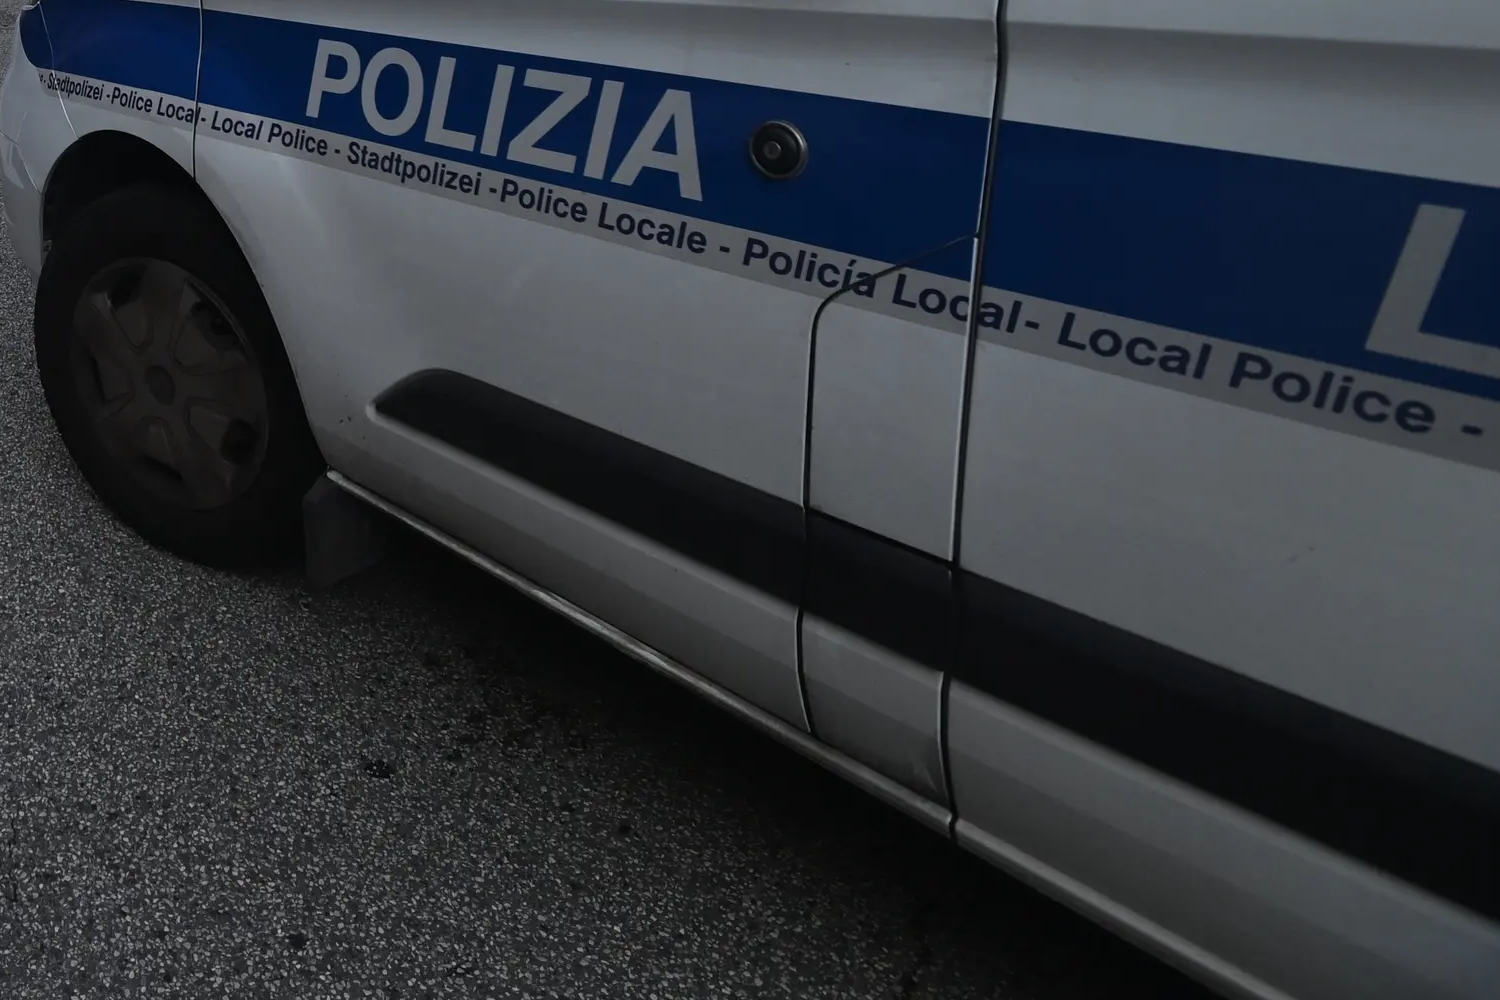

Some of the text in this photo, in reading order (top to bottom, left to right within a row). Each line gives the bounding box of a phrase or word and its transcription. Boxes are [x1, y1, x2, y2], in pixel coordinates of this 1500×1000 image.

[305, 38, 703, 202] POLIZIA
[47, 73, 104, 101] Stadtpolizei
[211, 110, 264, 140] Local
[268, 123, 328, 157] Police
[347, 141, 482, 195] Stadtpolizei
[598, 202, 707, 254] Locale
[743, 237, 877, 298] Policía
[1057, 312, 1213, 380] Local
[1228, 351, 1436, 434] Police
